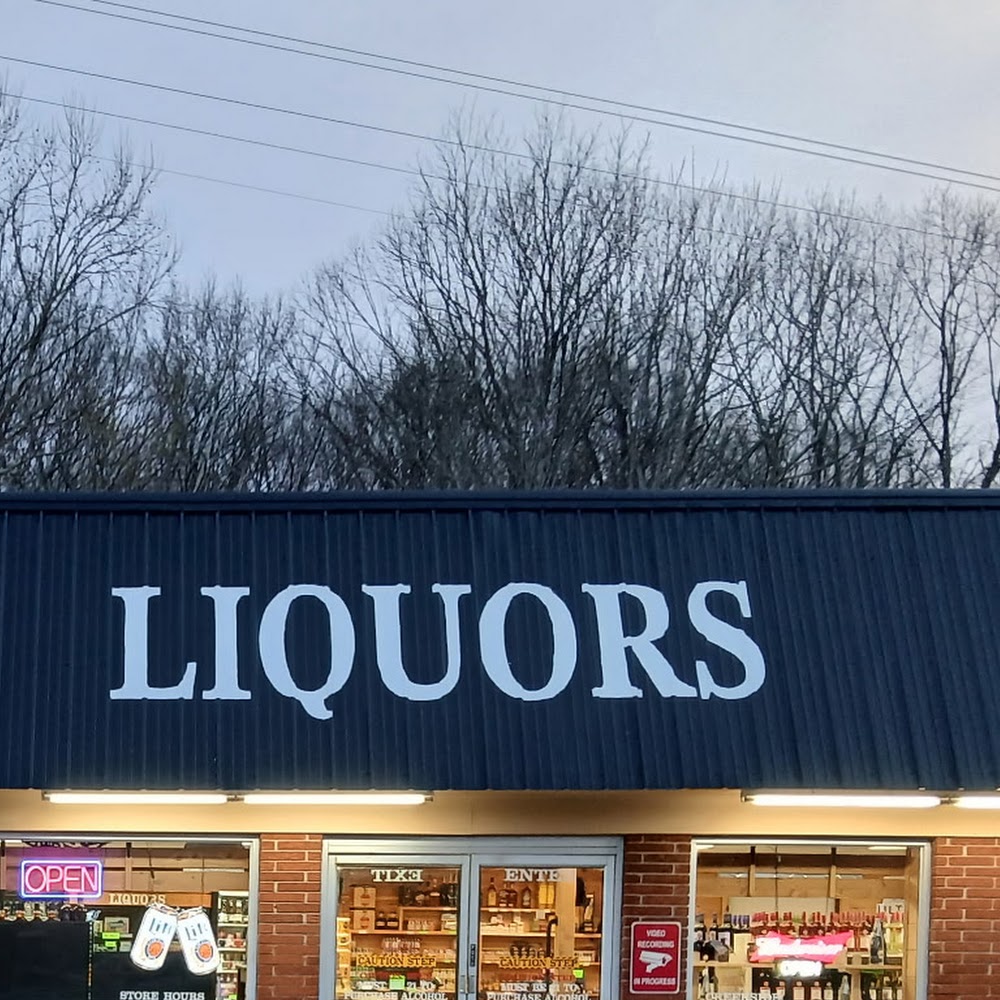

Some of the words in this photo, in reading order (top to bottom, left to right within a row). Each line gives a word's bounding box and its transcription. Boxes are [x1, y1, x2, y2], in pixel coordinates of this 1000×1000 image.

[109, 580, 766, 719] LIQUORS
[25, 865, 98, 893] OPEN
[646, 929, 666, 937] VIDEO
[358, 956, 404, 967] CAUTION
[407, 957, 436, 967] STEP
[500, 959, 546, 968] CAUTION
[551, 959, 579, 968] STEP
[642, 977, 676, 985] PROGRESS
[501, 983, 530, 992] MUST
[120, 990, 159, 1000] STORE
[401, 991, 449, 1000] ALCOHOL
